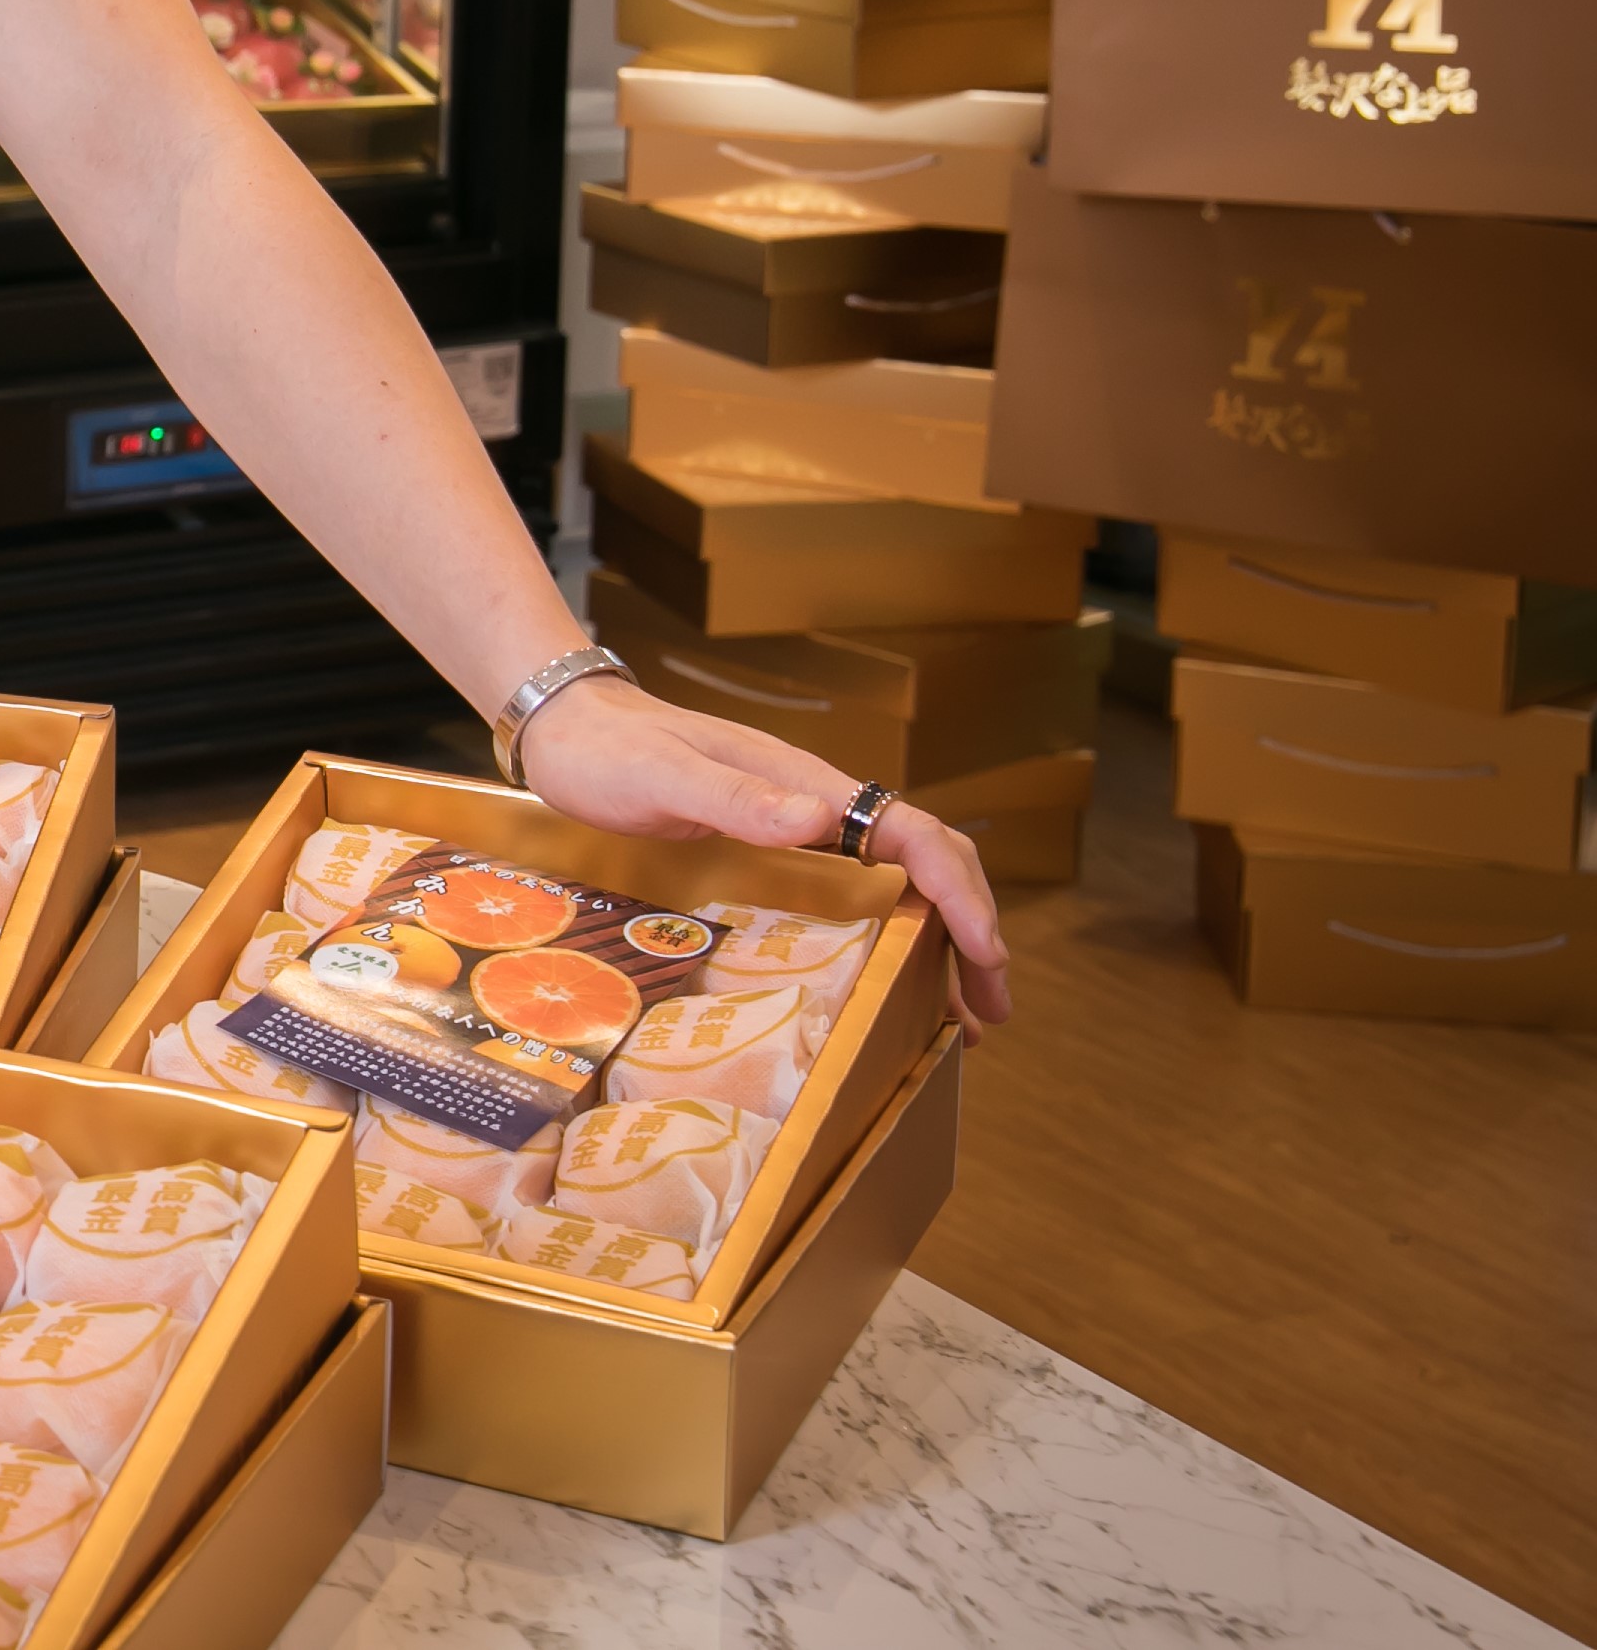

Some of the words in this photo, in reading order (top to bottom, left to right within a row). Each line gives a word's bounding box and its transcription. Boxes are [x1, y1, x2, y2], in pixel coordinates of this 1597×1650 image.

[364, 874, 452, 940] みかん
[449, 855, 615, 910] 日本の美味しい
